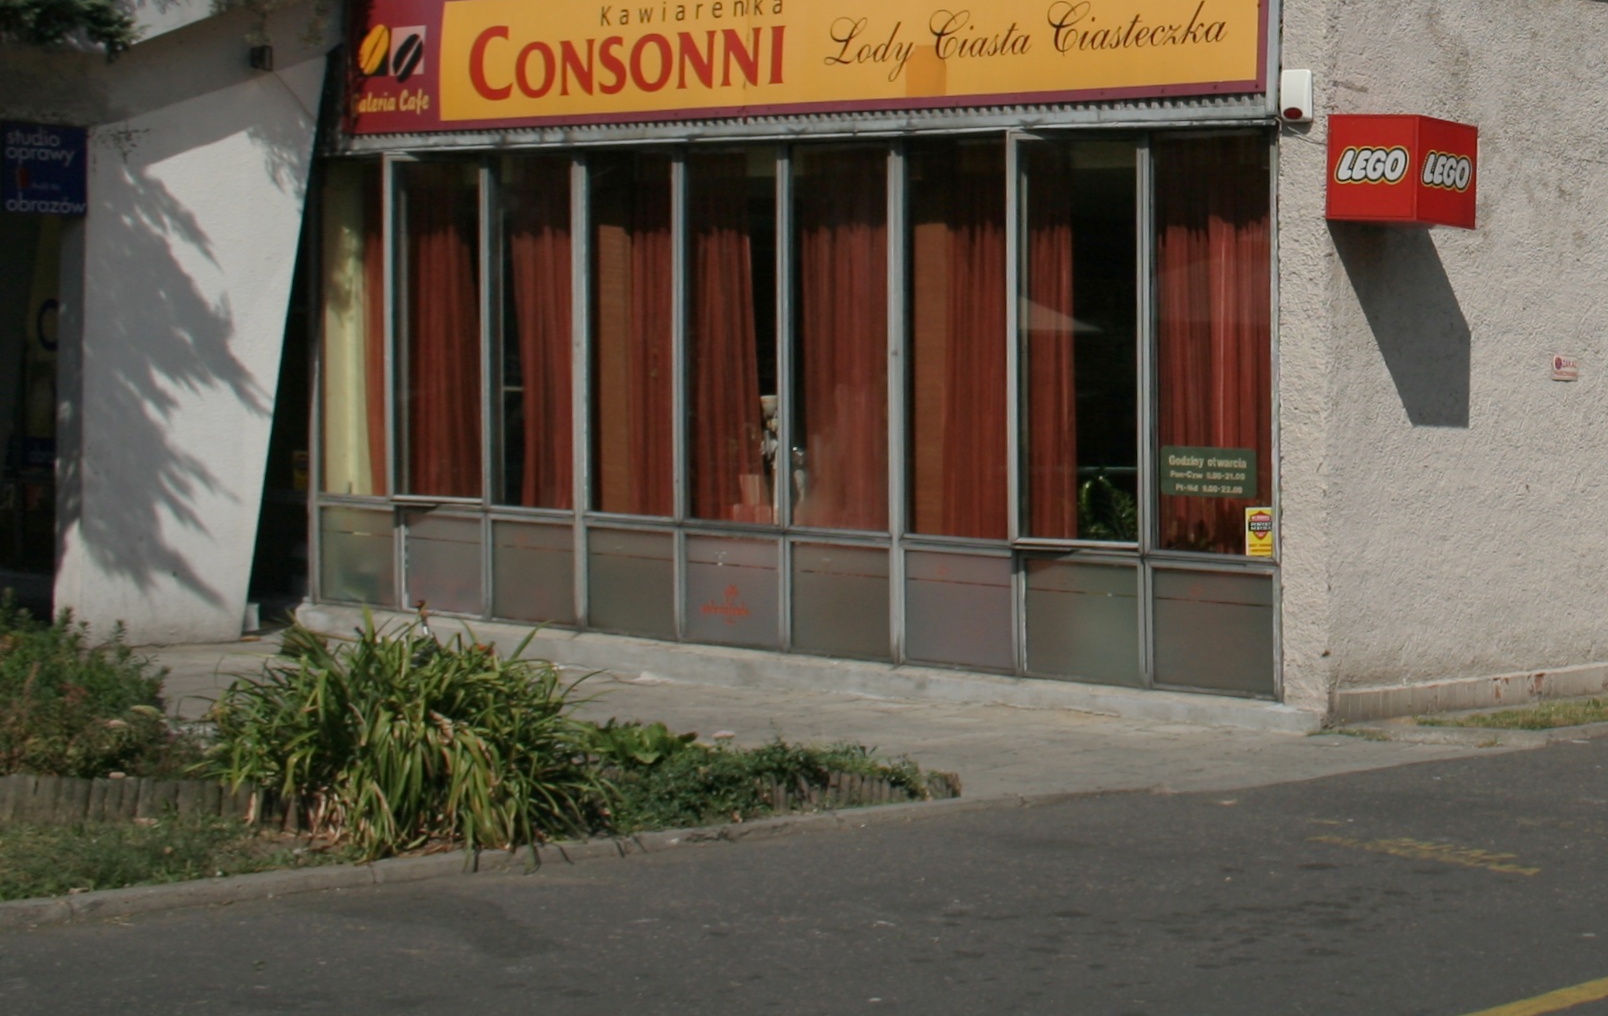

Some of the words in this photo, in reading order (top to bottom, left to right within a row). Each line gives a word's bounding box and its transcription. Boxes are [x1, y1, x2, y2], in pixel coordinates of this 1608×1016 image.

[824, 16, 914, 82] Lody
[929, 9, 1031, 60] Ciasta
[1047, 0, 1227, 57] Ciasteczka
[469, 25, 786, 101] CONSONNI
[399, 88, 430, 115] Cafe
[7, 127, 60, 147] studio
[5, 146, 75, 167] oprawy
[1335, 146, 1408, 184] LEGO
[1422, 151, 1471, 192] LEGO
[6, 191, 86, 214] obrazów
[1168, 455, 1204, 469] Godziny
[1207, 457, 1247, 469] otwarcia
